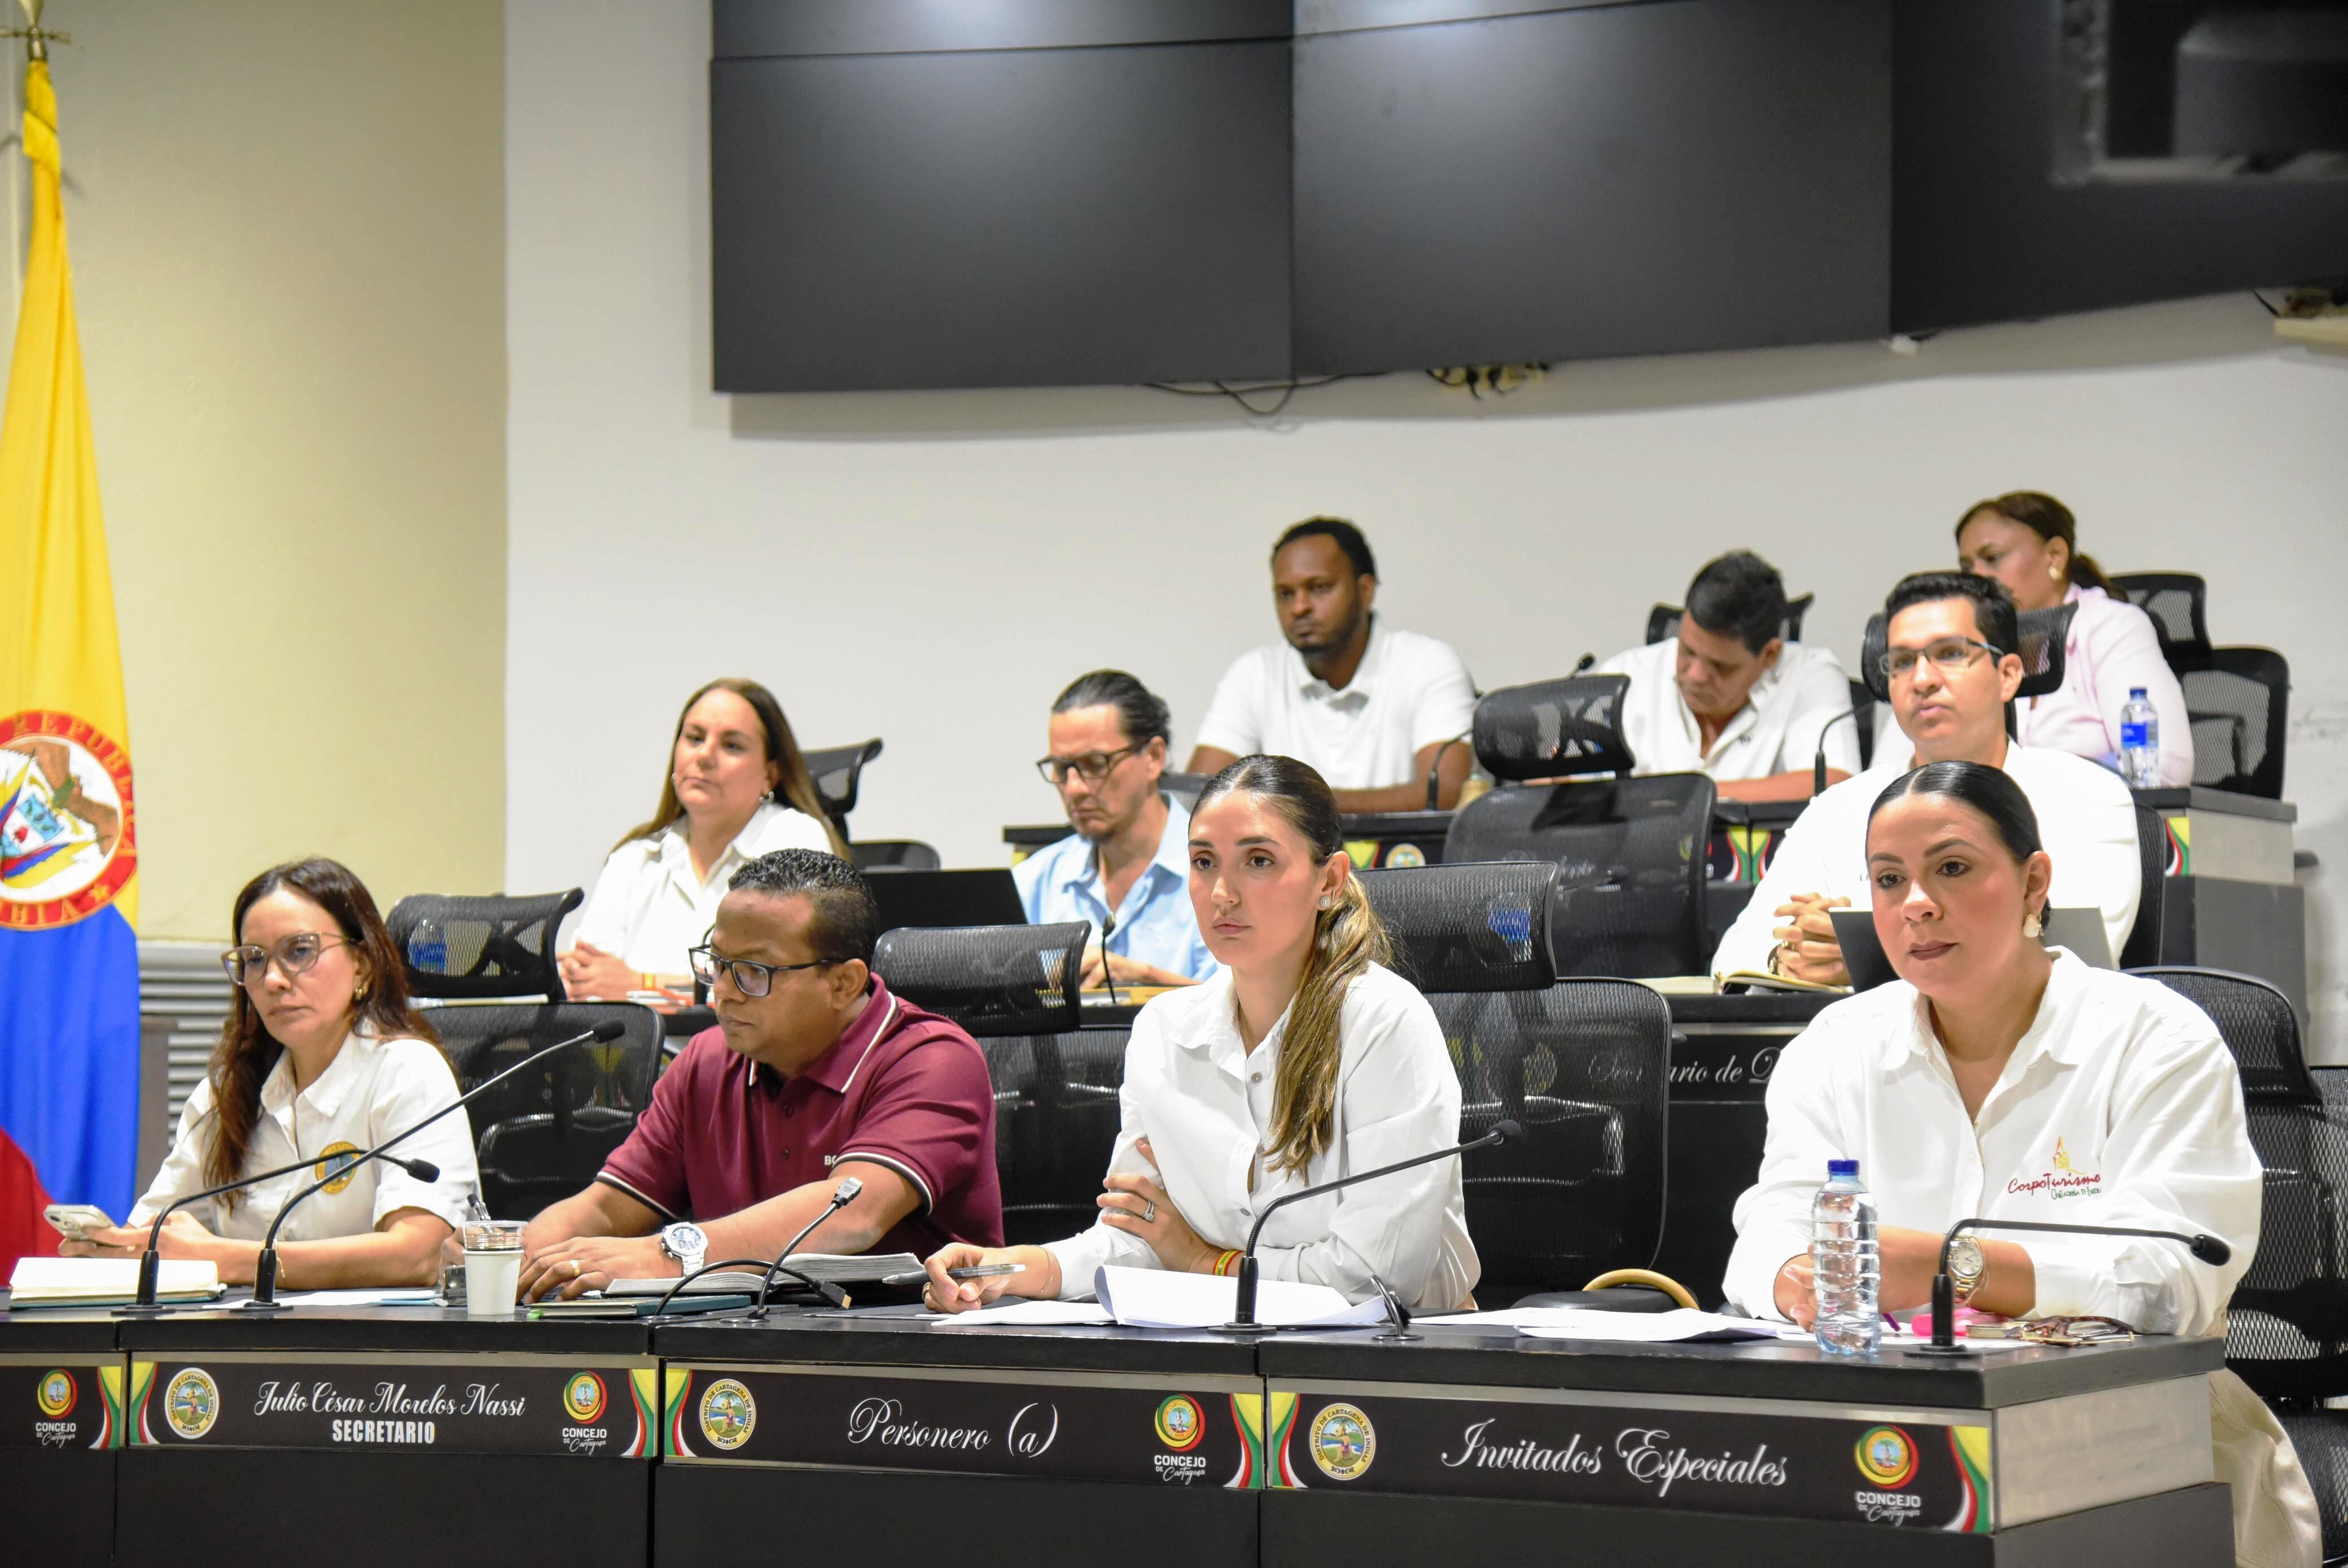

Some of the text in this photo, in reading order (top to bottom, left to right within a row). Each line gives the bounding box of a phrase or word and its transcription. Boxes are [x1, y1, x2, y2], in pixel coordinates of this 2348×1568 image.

[1715, 1054, 1743, 1084] de
[2008, 1172, 2101, 1196] CorpoTurismo
[254, 1381, 527, 1417] Julio César Morelos Nassi
[715, 1384, 747, 1400] CARTAGENA
[742, 1411, 752, 1434] INDIAS
[35, 1422, 77, 1433] CONCEJO
[332, 1419, 436, 1445] SECRETARIO
[562, 1427, 607, 1439] CONCEJO
[848, 1397, 1059, 1458] Personero (a)
[1315, 1426, 1324, 1461] DISTRITO
[1327, 1408, 1364, 1425] CARTAGENA
[1361, 1437, 1370, 1462] INDIAS
[569, 1438, 607, 1456] Cartagena
[1441, 1417, 1789, 1498] Invitados Especiales
[1154, 1454, 1207, 1468] CONCEJO
[1162, 1466, 1206, 1486] Cartagena
[1856, 1492, 1921, 1508] CONCEJO
